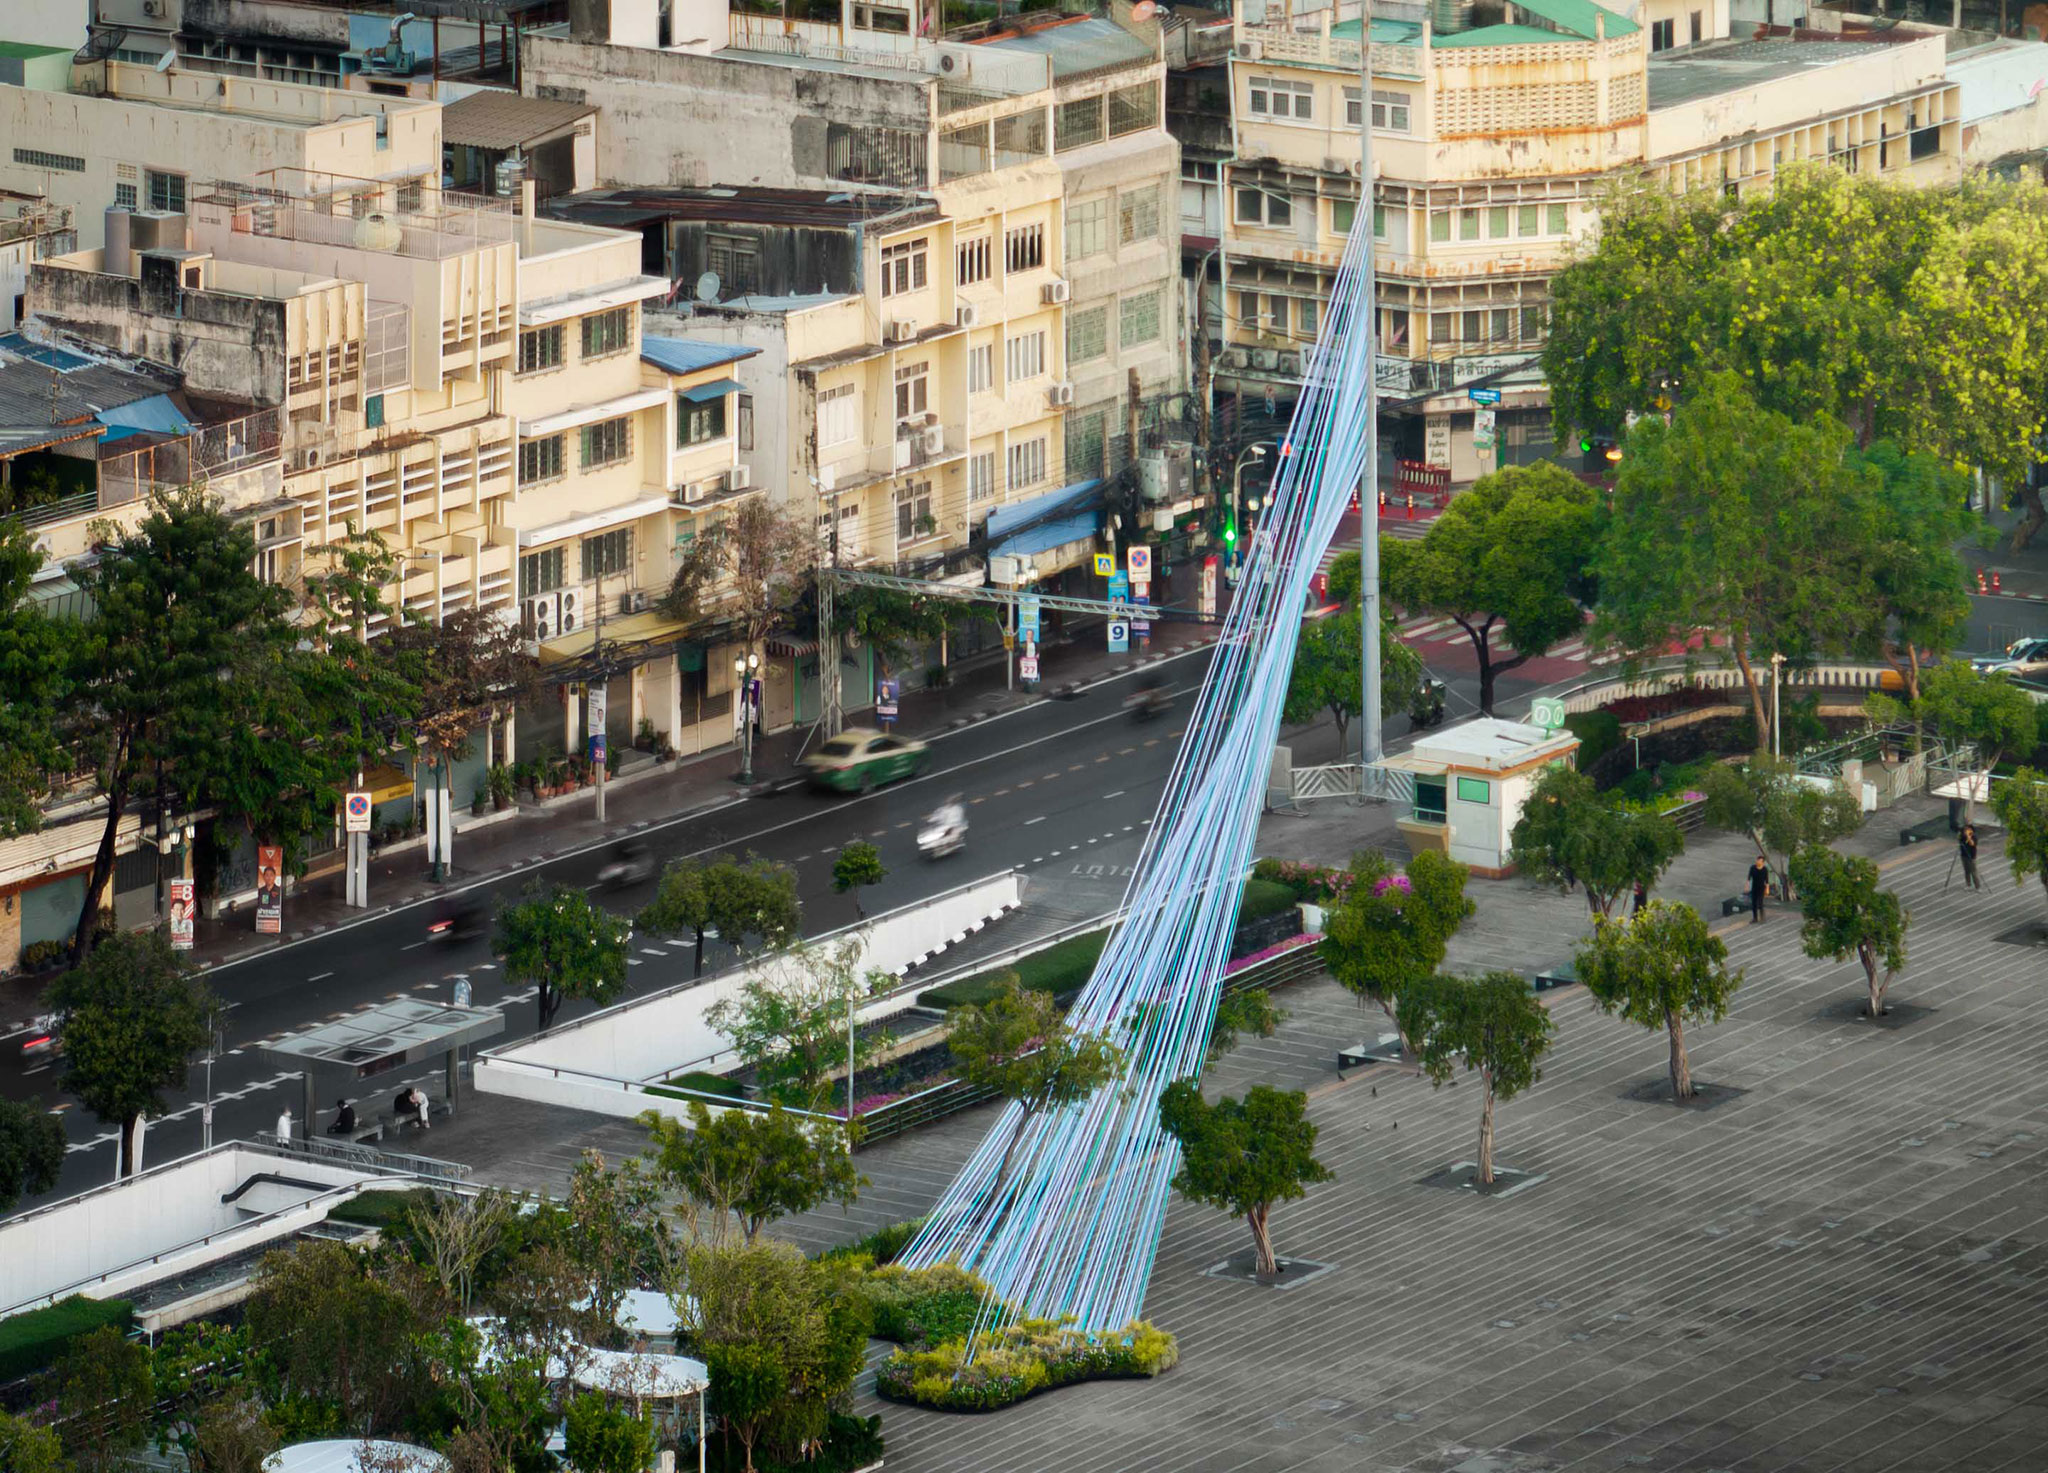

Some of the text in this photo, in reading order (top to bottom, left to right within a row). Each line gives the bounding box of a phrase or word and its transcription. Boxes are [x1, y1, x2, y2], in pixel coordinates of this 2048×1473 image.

[1112, 626, 1124, 640] 9
[1024, 666, 1035, 674] 27
[595, 750, 604, 759] 23
[182, 886, 192, 900] 8
